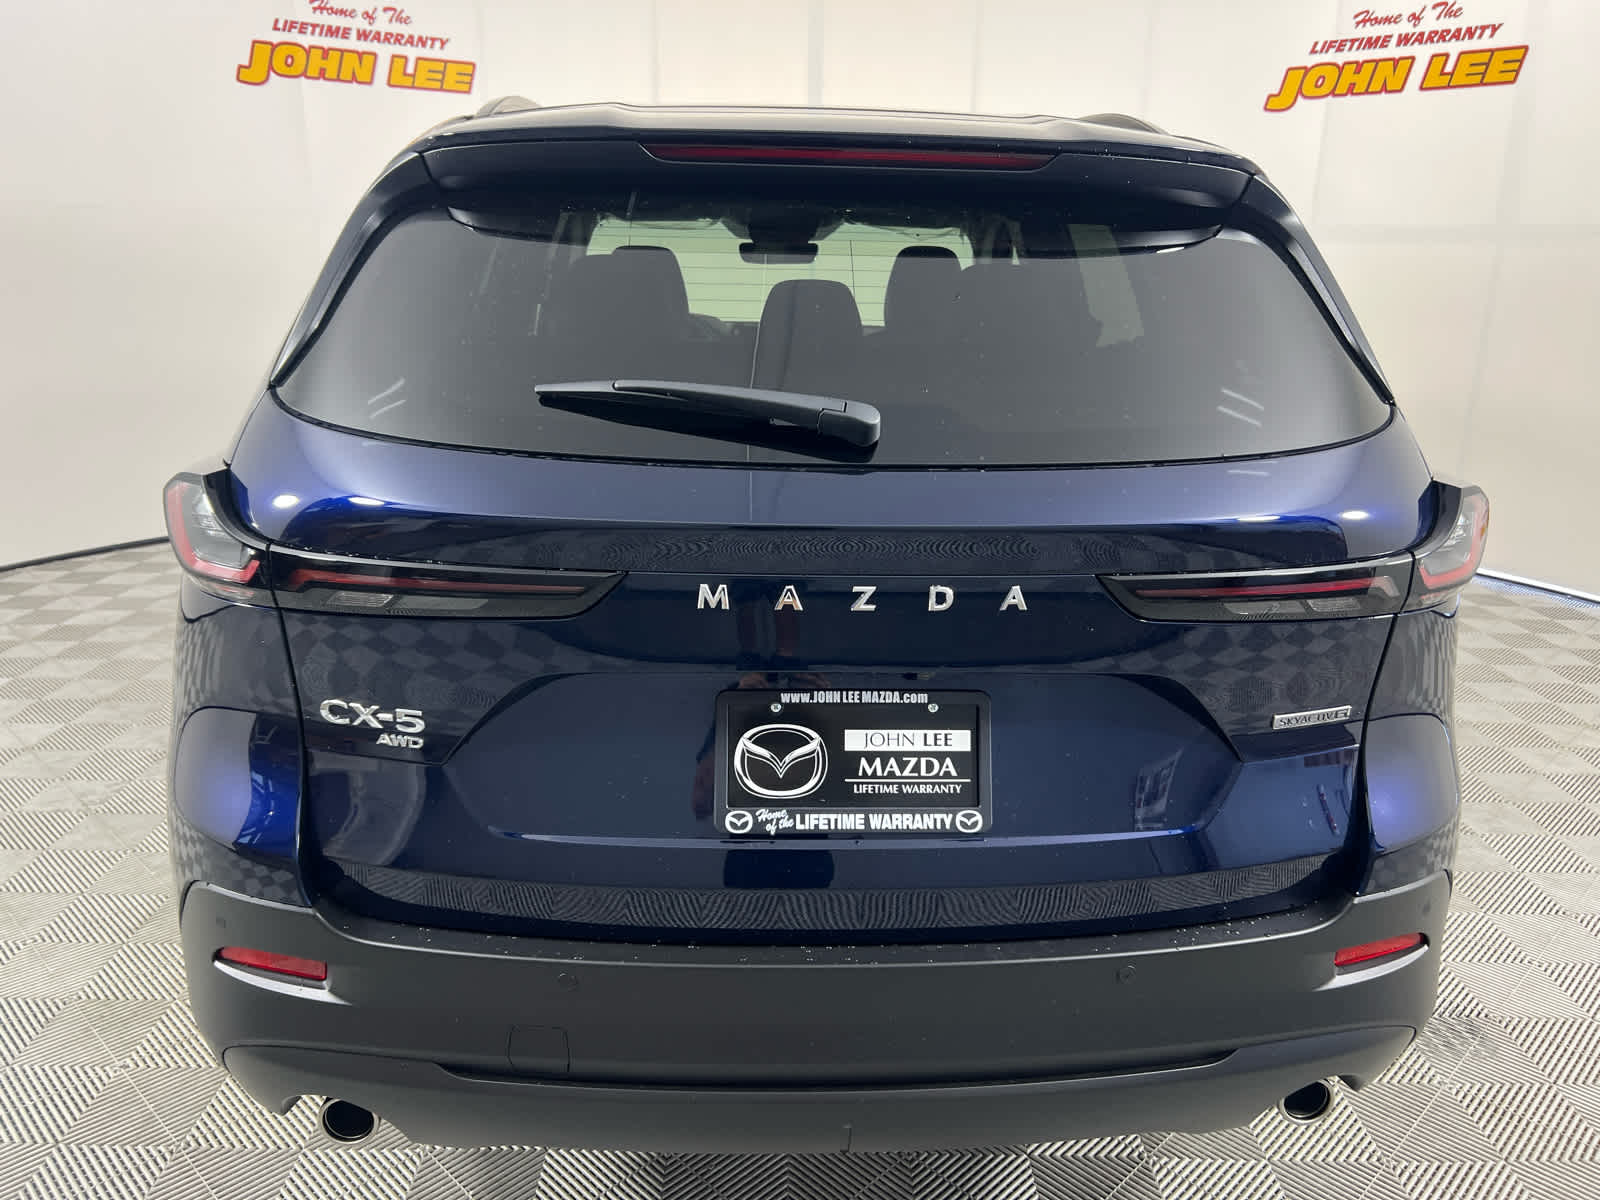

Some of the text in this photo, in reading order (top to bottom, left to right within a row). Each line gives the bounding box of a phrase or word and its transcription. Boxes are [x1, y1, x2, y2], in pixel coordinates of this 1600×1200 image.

[309, 0, 412, 26] Home of The
[1353, 1, 1463, 28] Home of The
[272, 18, 450, 50] LIFETIME WARRANTY
[1309, 23, 1503, 55] LIFETIME WARRANTY
[236, 40, 476, 94] JOHN LEE
[1264, 45, 1529, 112] JOHN LEE
[697, 583, 1028, 612] MAZDA
[320, 699, 425, 733] CX-5
[376, 733, 424, 749] AWD
[864, 732, 953, 749] JOHN LEE
[858, 757, 958, 776] MAZDA
[853, 784, 962, 794] LIFETIME WARRANTY
[755, 808, 787, 822] Home
[765, 815, 795, 836] of the
[795, 813, 953, 830] LIFETIME WARRANTY
